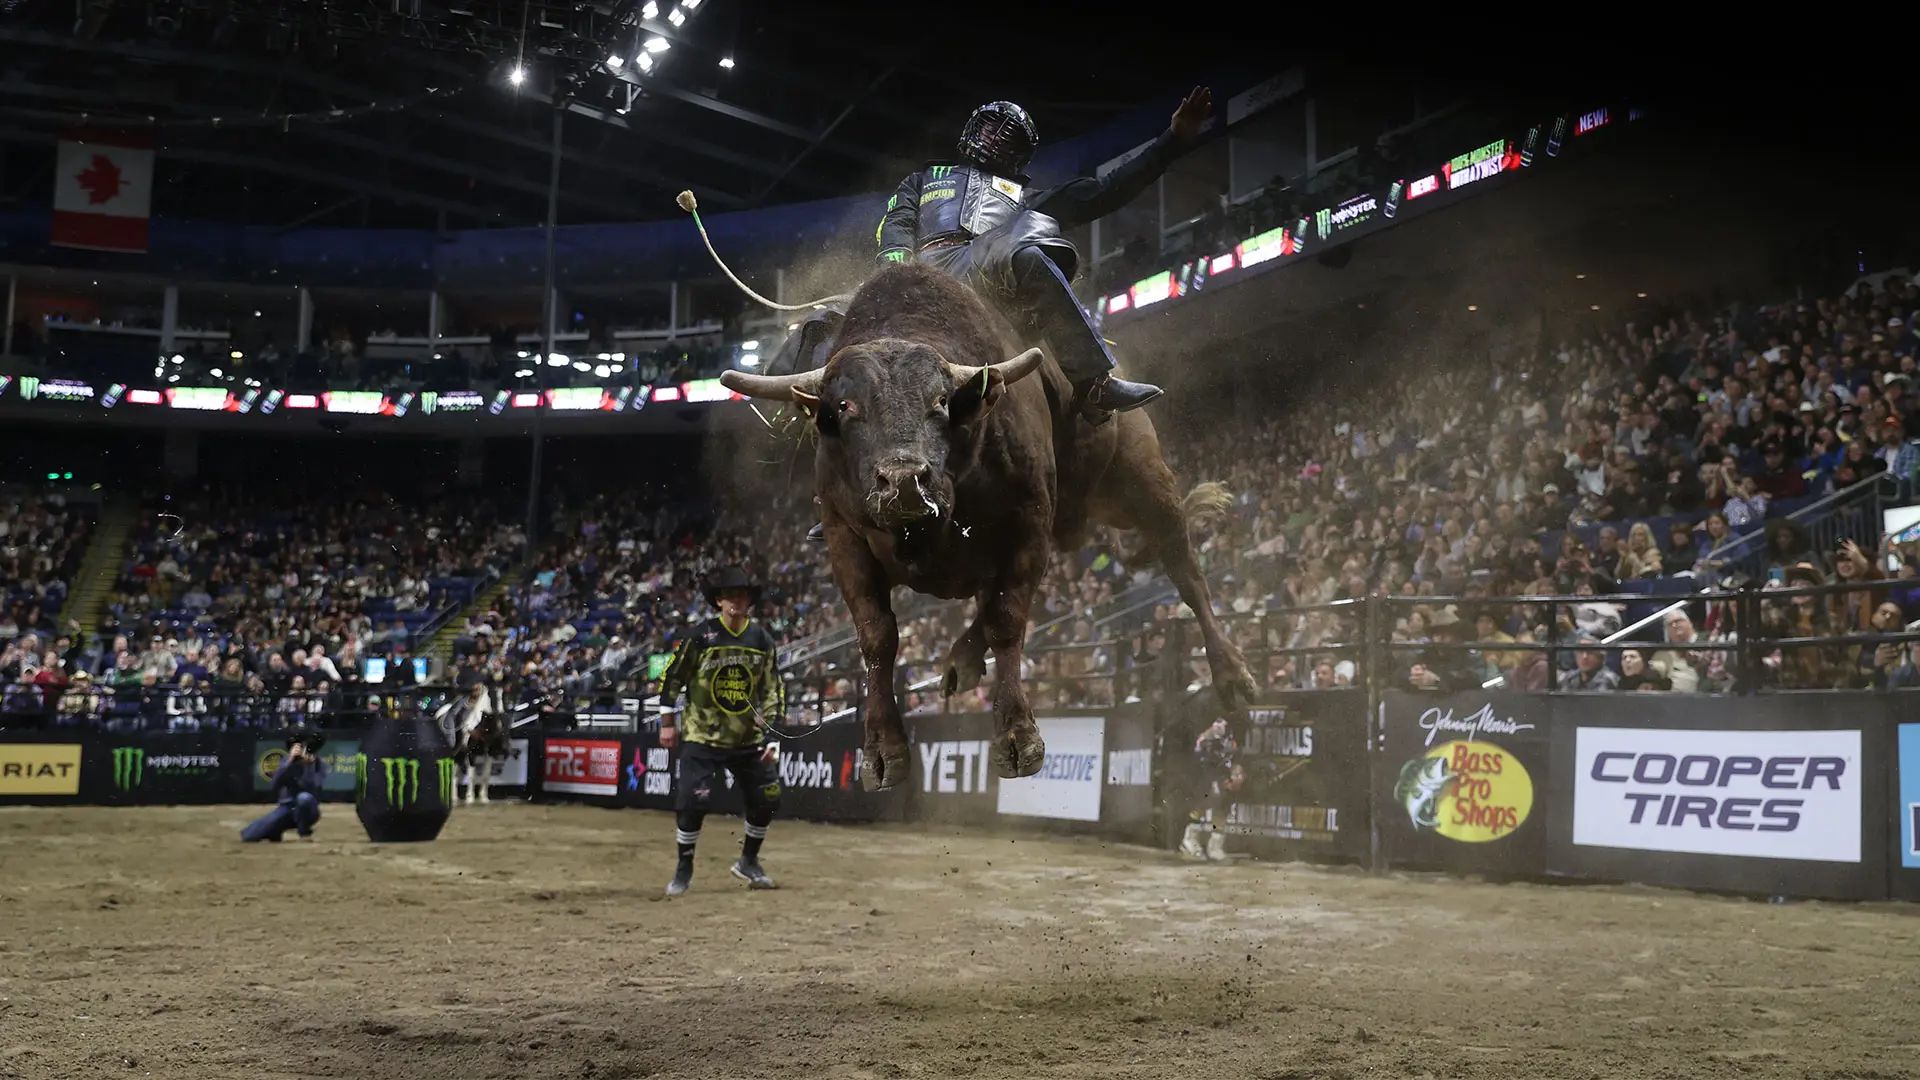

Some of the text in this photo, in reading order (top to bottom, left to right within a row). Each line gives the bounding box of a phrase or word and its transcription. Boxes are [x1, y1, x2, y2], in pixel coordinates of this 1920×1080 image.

[1579, 107, 1608, 132] NEW!
[146, 754, 220, 768] MONSTER
[546, 745, 587, 777] FRE
[779, 751, 832, 788] Kubota
[920, 739, 991, 793] YETI
[1031, 753, 1098, 781] RESSIVE
[1451, 744, 1503, 774] Bass
[1590, 752, 1846, 790] COOPER
[644, 771, 671, 795] CASINO
[1451, 772, 1491, 800] Pro
[1451, 797, 1518, 834] Shops
[1624, 792, 1805, 832] TIRES
